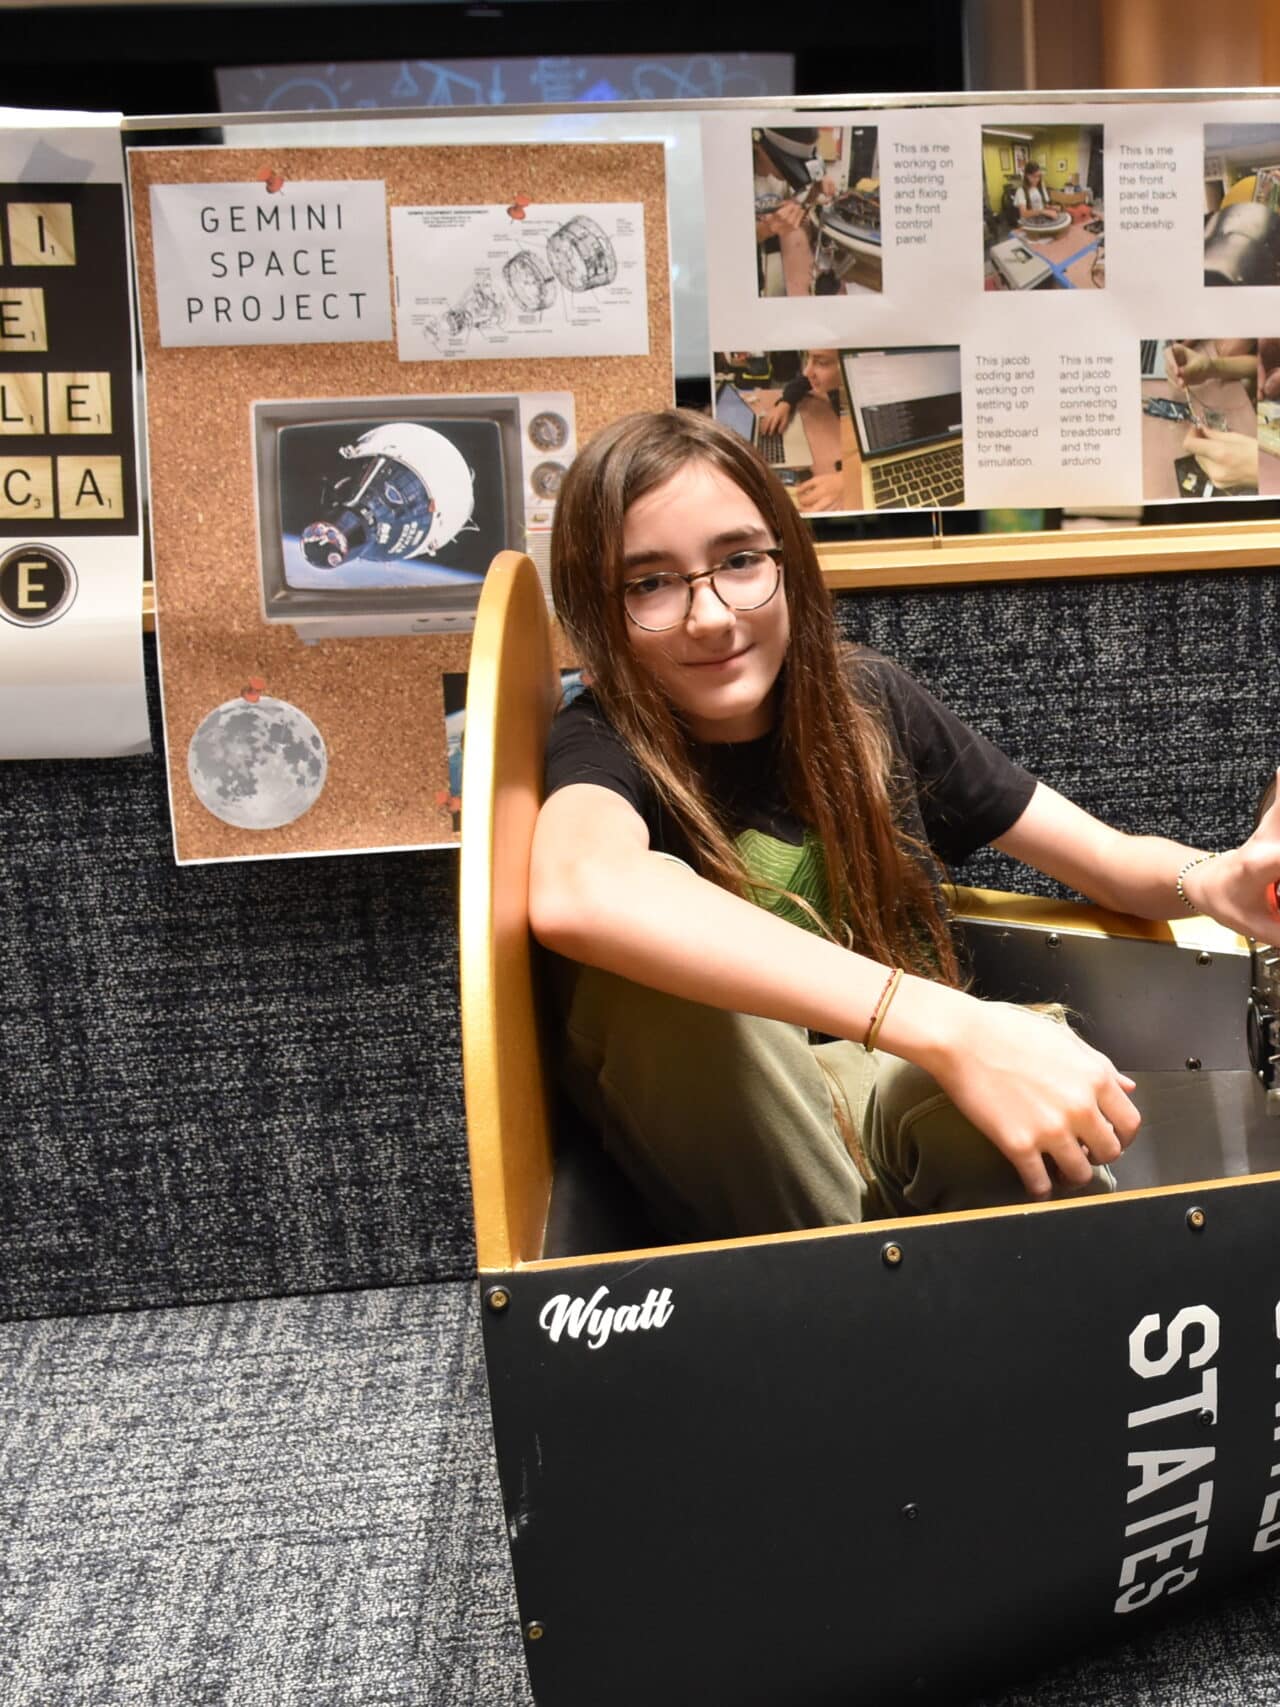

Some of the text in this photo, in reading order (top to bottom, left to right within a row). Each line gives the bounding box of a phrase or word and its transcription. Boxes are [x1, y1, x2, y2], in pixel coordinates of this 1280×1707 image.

[892, 143, 950, 153] This is me
[1120, 144, 1174, 155] This is me
[894, 159, 954, 171] working on
[1119, 160, 1177, 172] reinstalling
[894, 174, 945, 185] soldering
[1119, 174, 1163, 185] the front
[894, 188, 948, 200] and fixing
[1119, 189, 1177, 201] panel back
[894, 203, 941, 214] the front
[1120, 205, 1159, 215] into the
[202, 206, 344, 232] GEMINI
[895, 219, 933, 229] control
[211, 250, 338, 277] SPACE
[187, 293, 366, 323] PROJECT
[976, 355, 1031, 368] This jacob
[1059, 355, 1113, 365] This is me
[975, 370, 1035, 382] coding and
[1059, 369, 1111, 382] and jacob
[975, 385, 1035, 397] working on
[1059, 385, 1117, 396] working on
[976, 400, 1029, 411] setting up
[1059, 399, 1117, 411] connecting
[976, 415, 994, 425] the
[1060, 413, 1115, 423] wire to the
[976, 428, 1039, 439] breadboard
[1060, 427, 1121, 438] breadboard
[978, 443, 1012, 453] for the
[1061, 442, 1100, 452] and the
[17, 561, 48, 609] E
[536, 1284, 676, 1351] Wyatt
[1113, 1304, 1221, 1614] STATES
